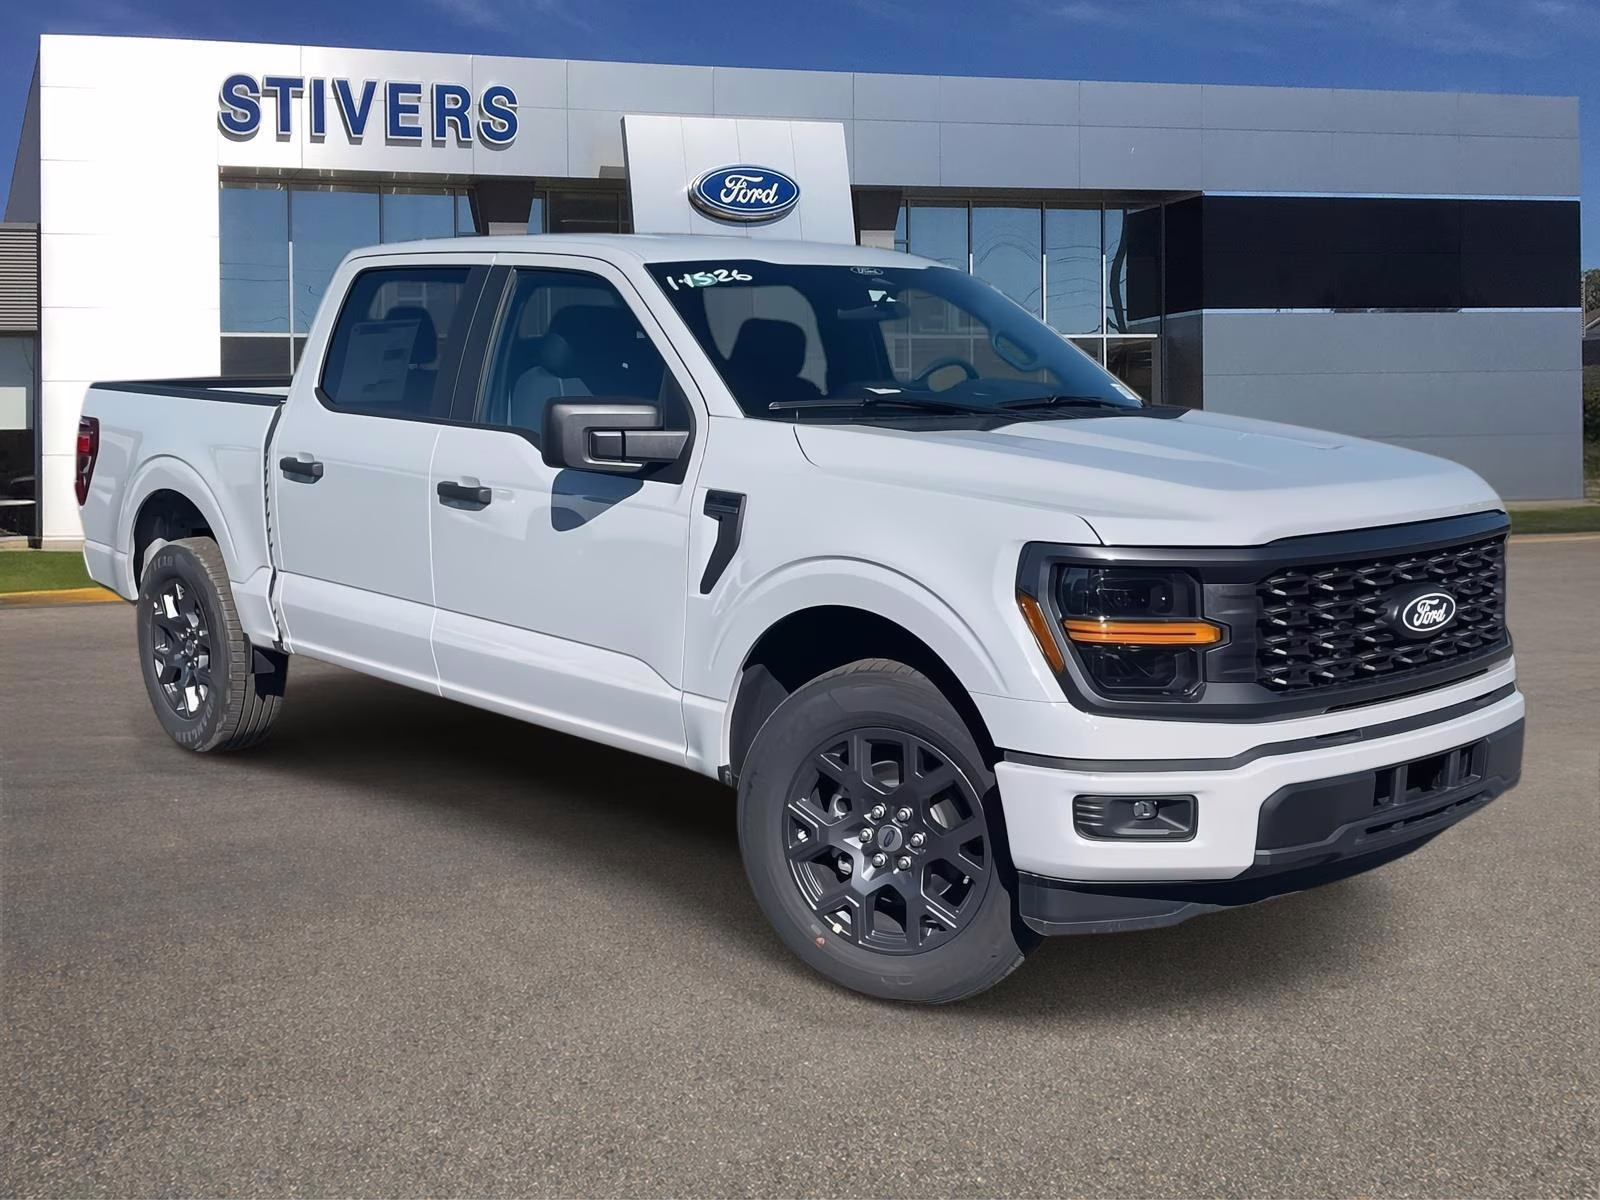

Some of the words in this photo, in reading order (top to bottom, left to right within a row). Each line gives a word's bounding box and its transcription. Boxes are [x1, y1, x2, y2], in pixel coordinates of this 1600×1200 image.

[218, 73, 519, 145] STIVERS
[720, 174, 779, 204] Ford
[1413, 598, 1447, 627] Ford
